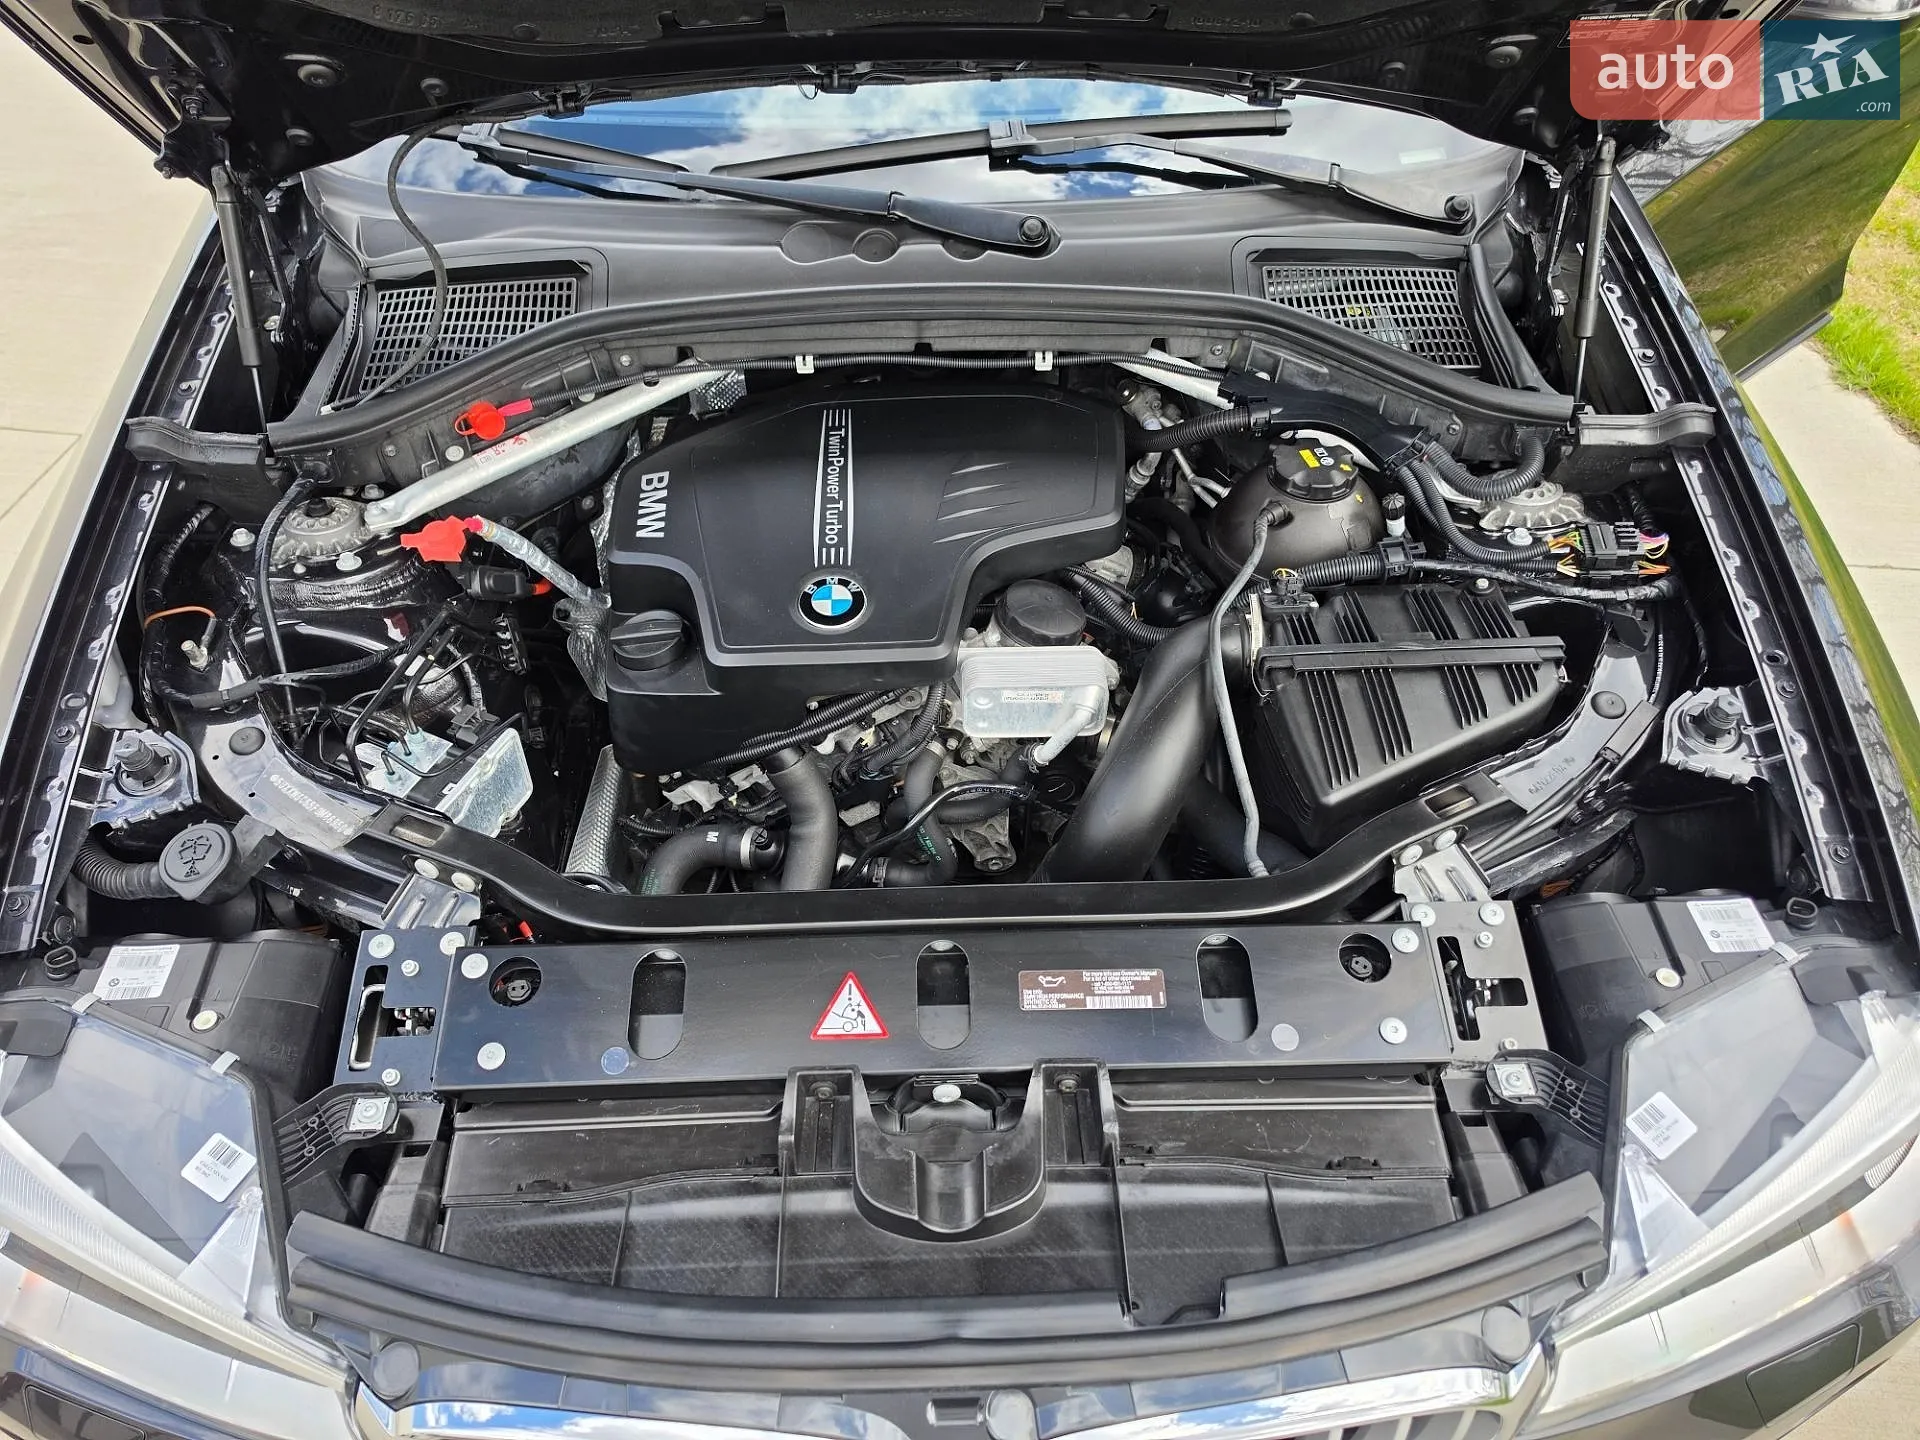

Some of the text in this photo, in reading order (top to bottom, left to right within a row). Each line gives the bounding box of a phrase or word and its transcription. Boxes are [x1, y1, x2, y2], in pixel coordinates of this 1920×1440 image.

[636, 471, 670, 538] BMW
[825, 427, 846, 544] TwinPower Turbo
[804, 576, 861, 594] BMW
